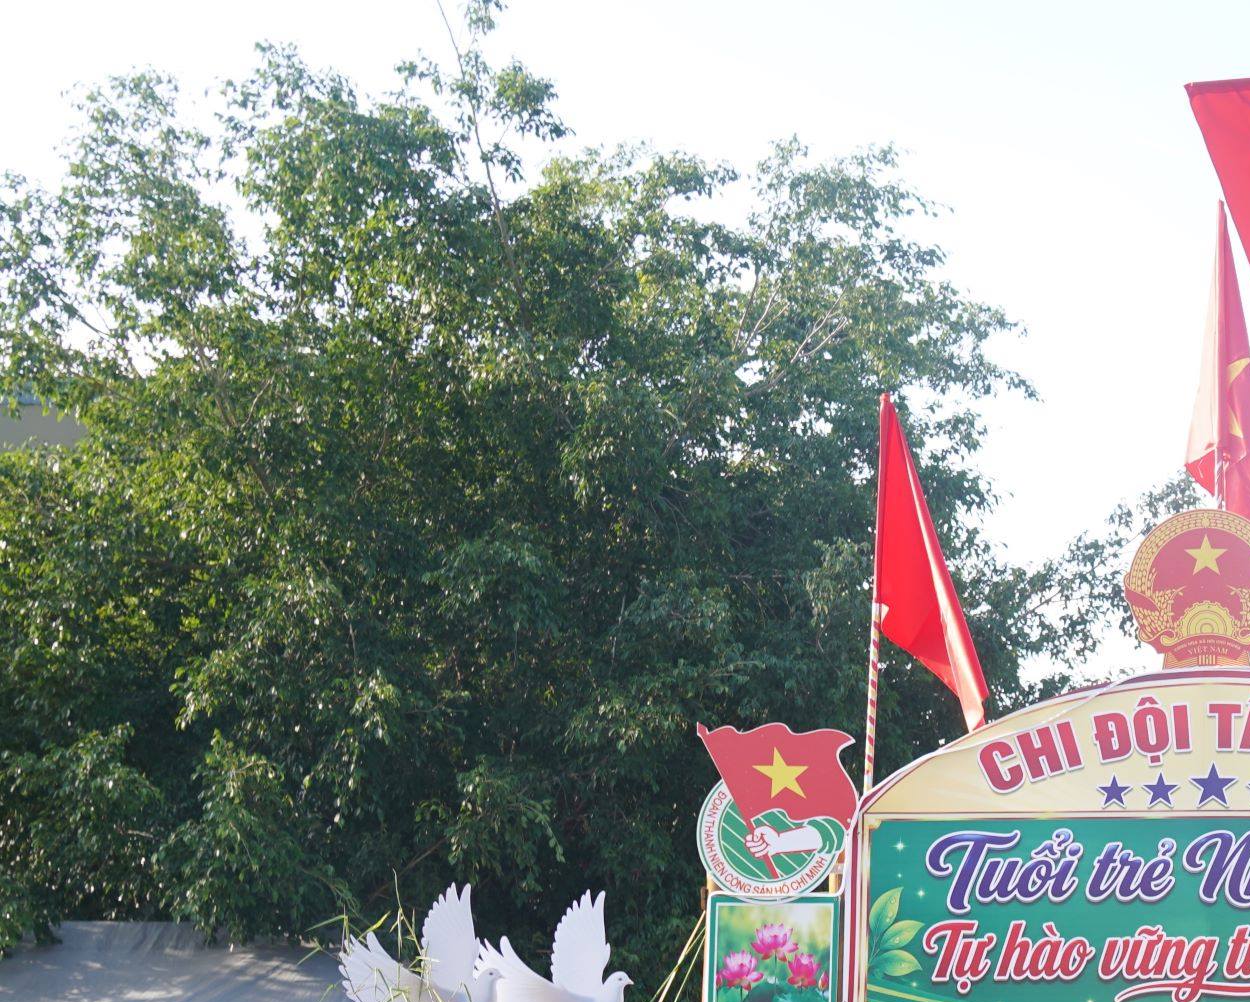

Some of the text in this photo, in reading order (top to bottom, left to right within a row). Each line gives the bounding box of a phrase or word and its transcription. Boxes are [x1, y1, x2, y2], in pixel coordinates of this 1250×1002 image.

[978, 719, 1083, 792] CHI
[1094, 696, 1191, 767] ĐỘI
[709, 853, 727, 876] NIÊN
[805, 855, 827, 880] MINH
[926, 829, 1083, 913] Tuổi
[1086, 838, 1176, 903] trẻ
[923, 920, 997, 993] Tự
[994, 920, 1095, 982] hào
